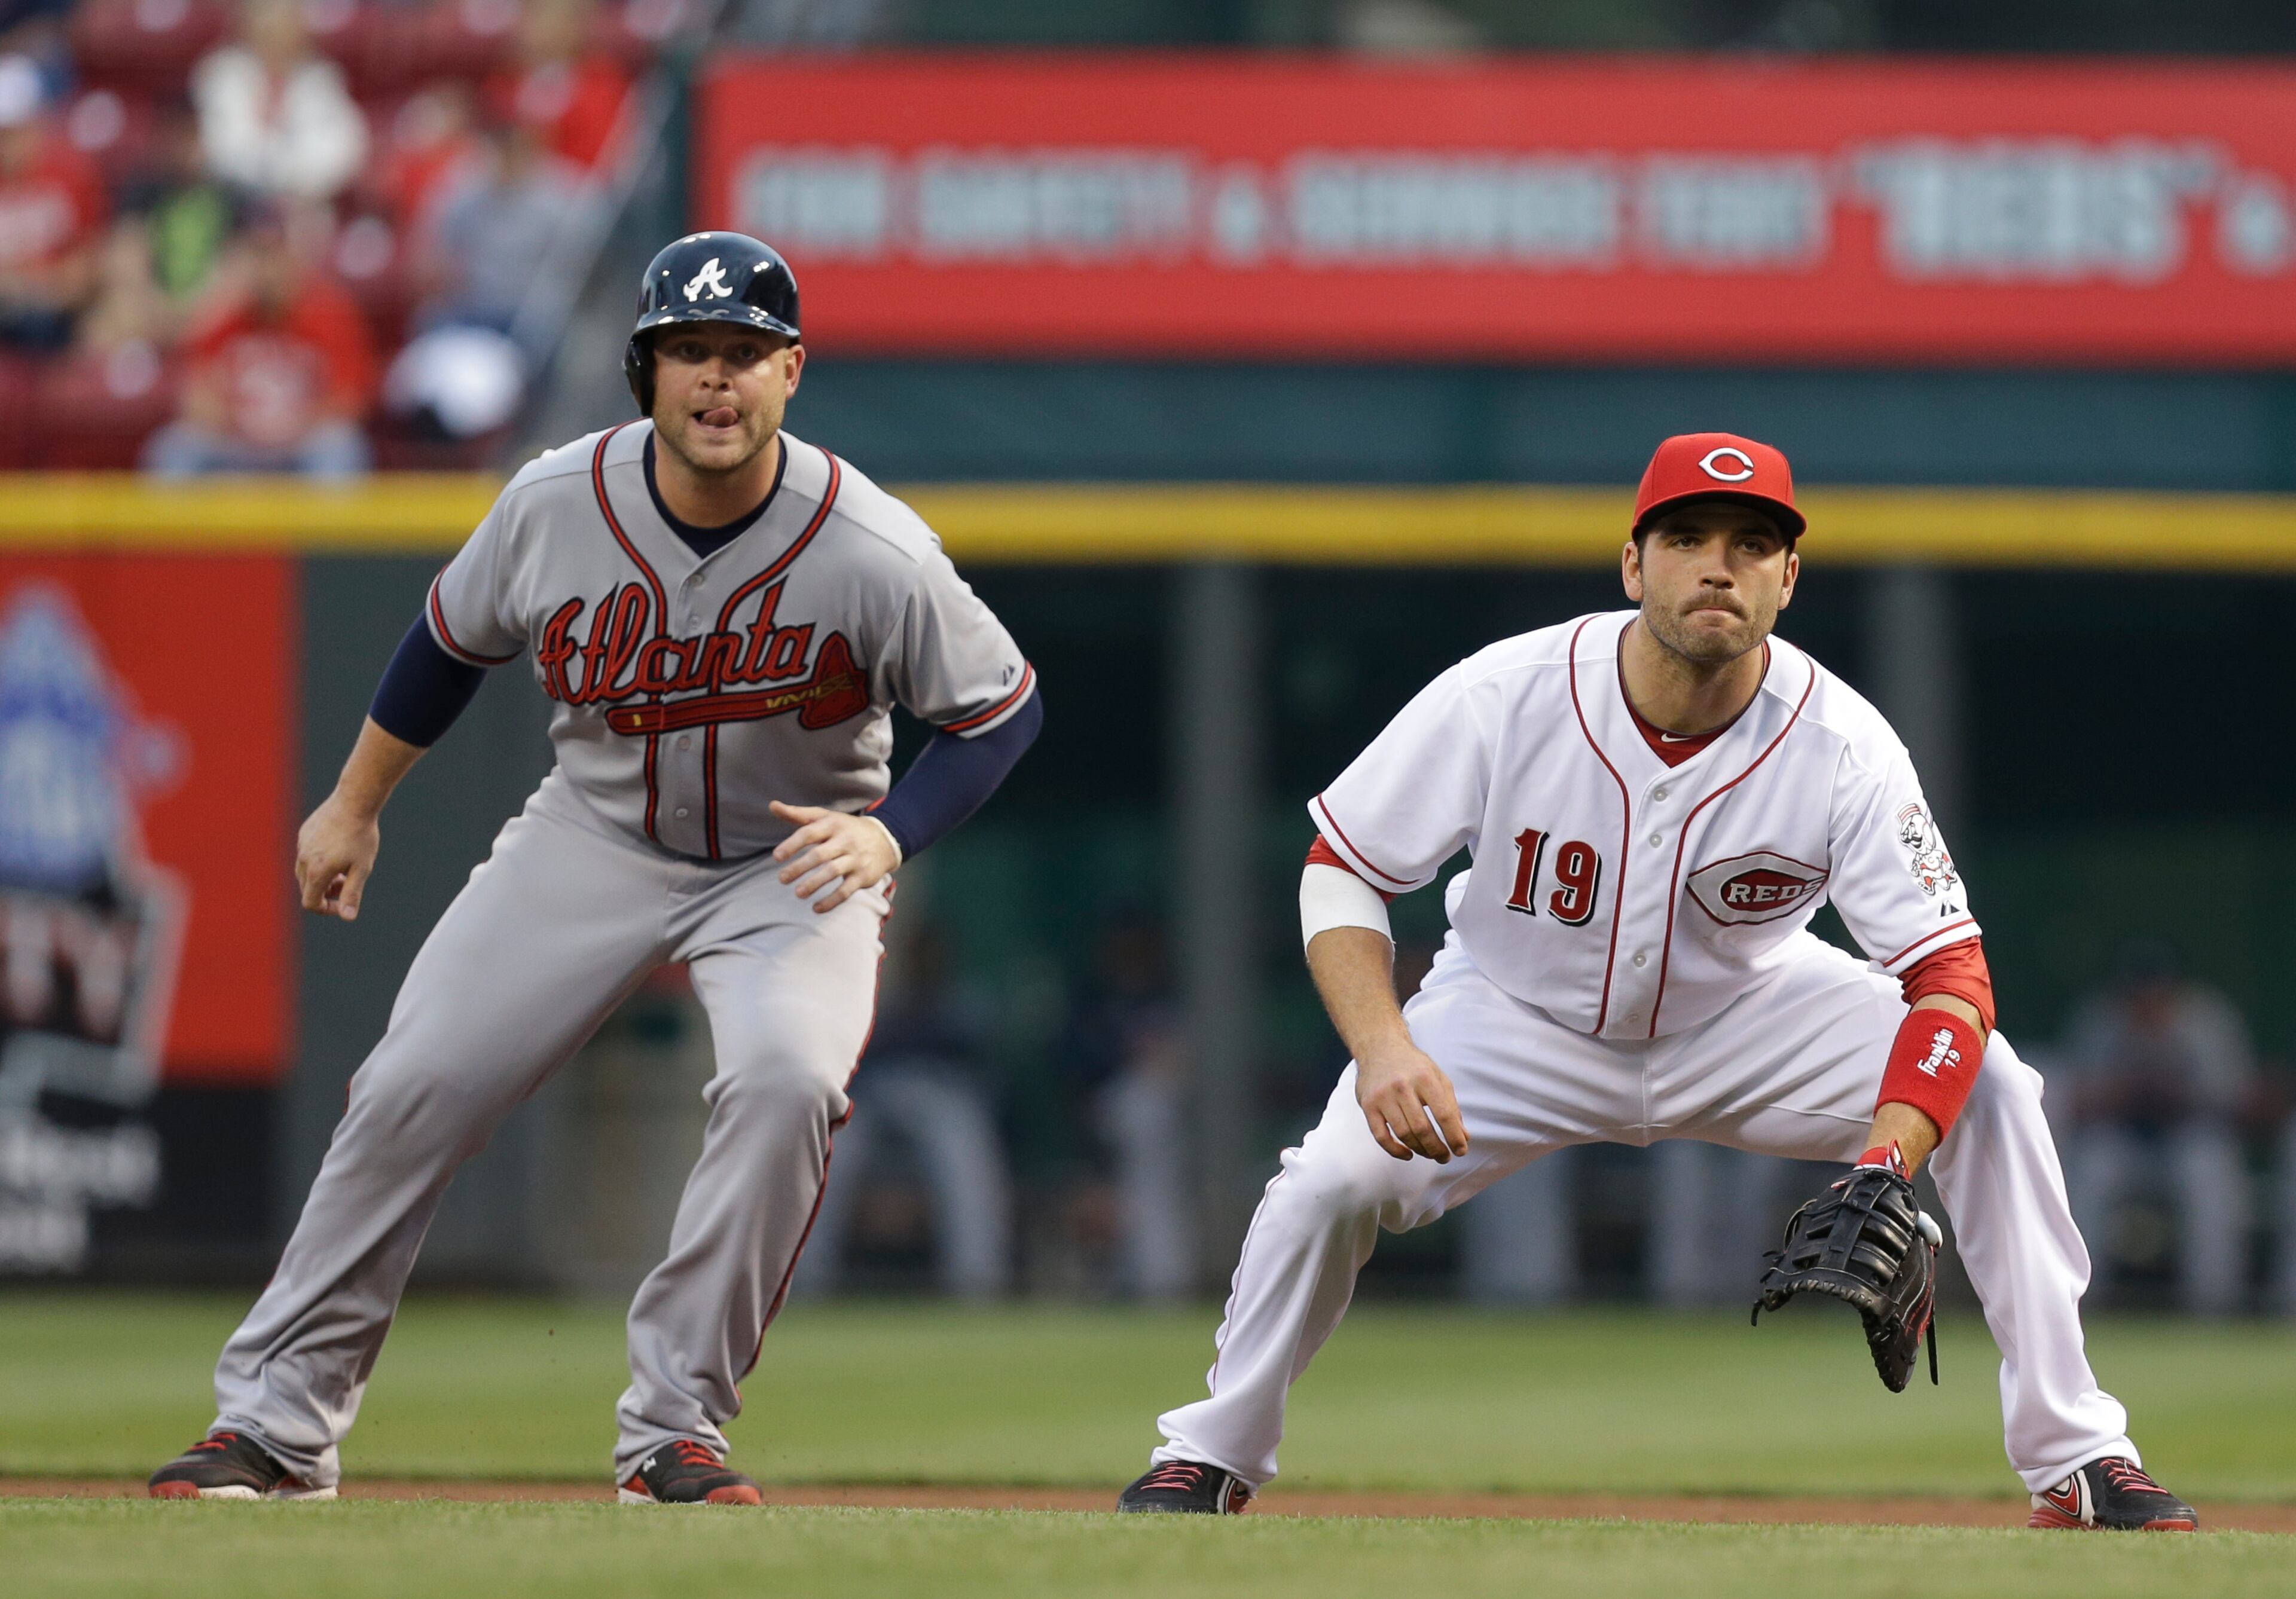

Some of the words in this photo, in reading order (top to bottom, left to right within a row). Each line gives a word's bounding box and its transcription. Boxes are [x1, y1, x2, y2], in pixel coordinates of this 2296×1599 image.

[683, 258, 733, 301] A
[1698, 447, 1754, 482] C
[539, 574, 817, 707] Atlanta
[1505, 827, 1602, 927] 19
[1727, 876, 1827, 904] REDS
[1944, 1049, 1961, 1068] 19
